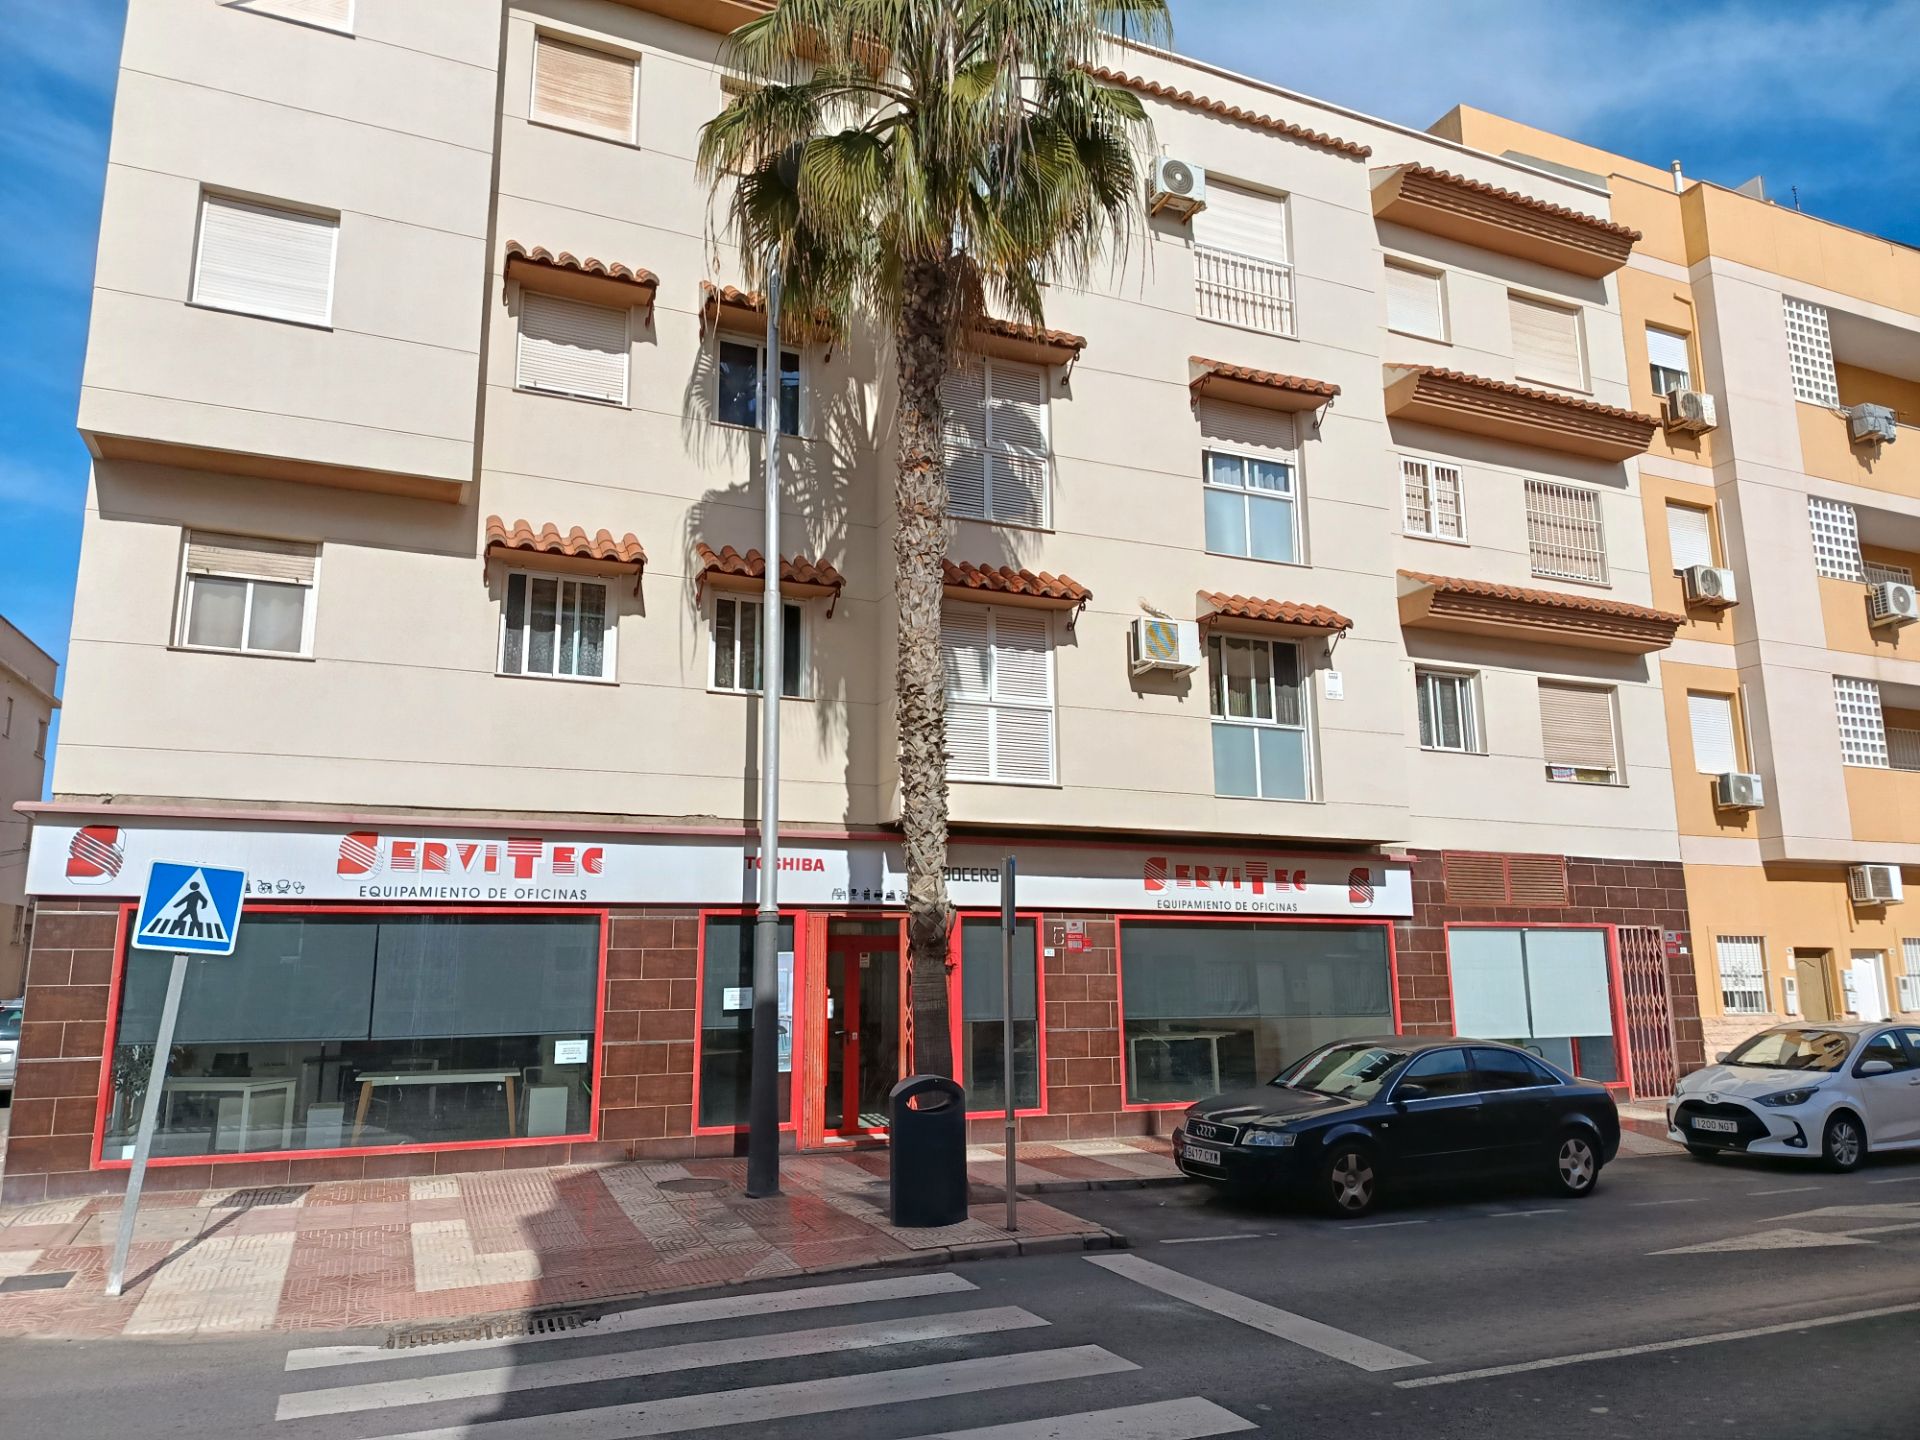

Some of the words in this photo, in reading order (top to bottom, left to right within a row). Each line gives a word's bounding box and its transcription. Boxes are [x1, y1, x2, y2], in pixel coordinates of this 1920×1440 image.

[359, 885, 481, 900] EQUIPAMIENTO
[488, 887, 507, 899] DE
[514, 888, 588, 900] OFICINAS
[1156, 899, 1232, 911] EQUIPAMIENTO
[1234, 900, 1248, 911] DE
[1251, 901, 1298, 912] OFICINAS
[1697, 1119, 1717, 1129] 1200
